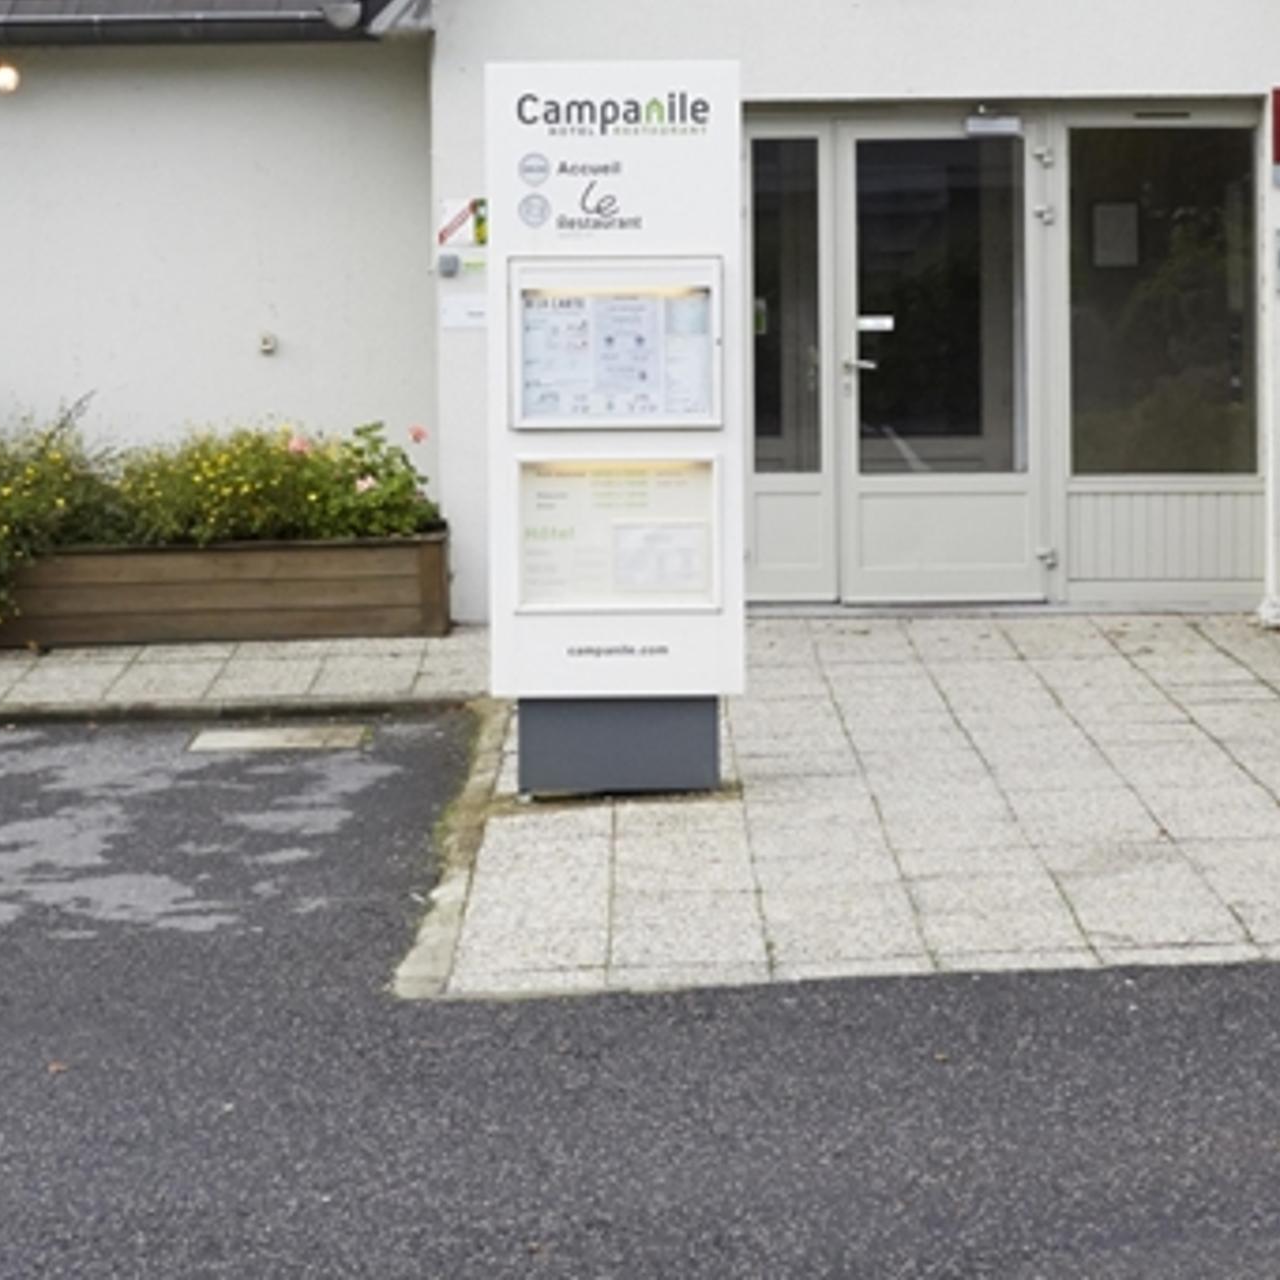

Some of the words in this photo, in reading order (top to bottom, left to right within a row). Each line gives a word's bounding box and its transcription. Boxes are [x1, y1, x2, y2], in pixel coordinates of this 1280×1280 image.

[517, 92, 710, 136] Campanile
[557, 161, 621, 176] Accueil
[557, 215, 642, 230] Restaurant
[567, 644, 670, 657] campanile.com
